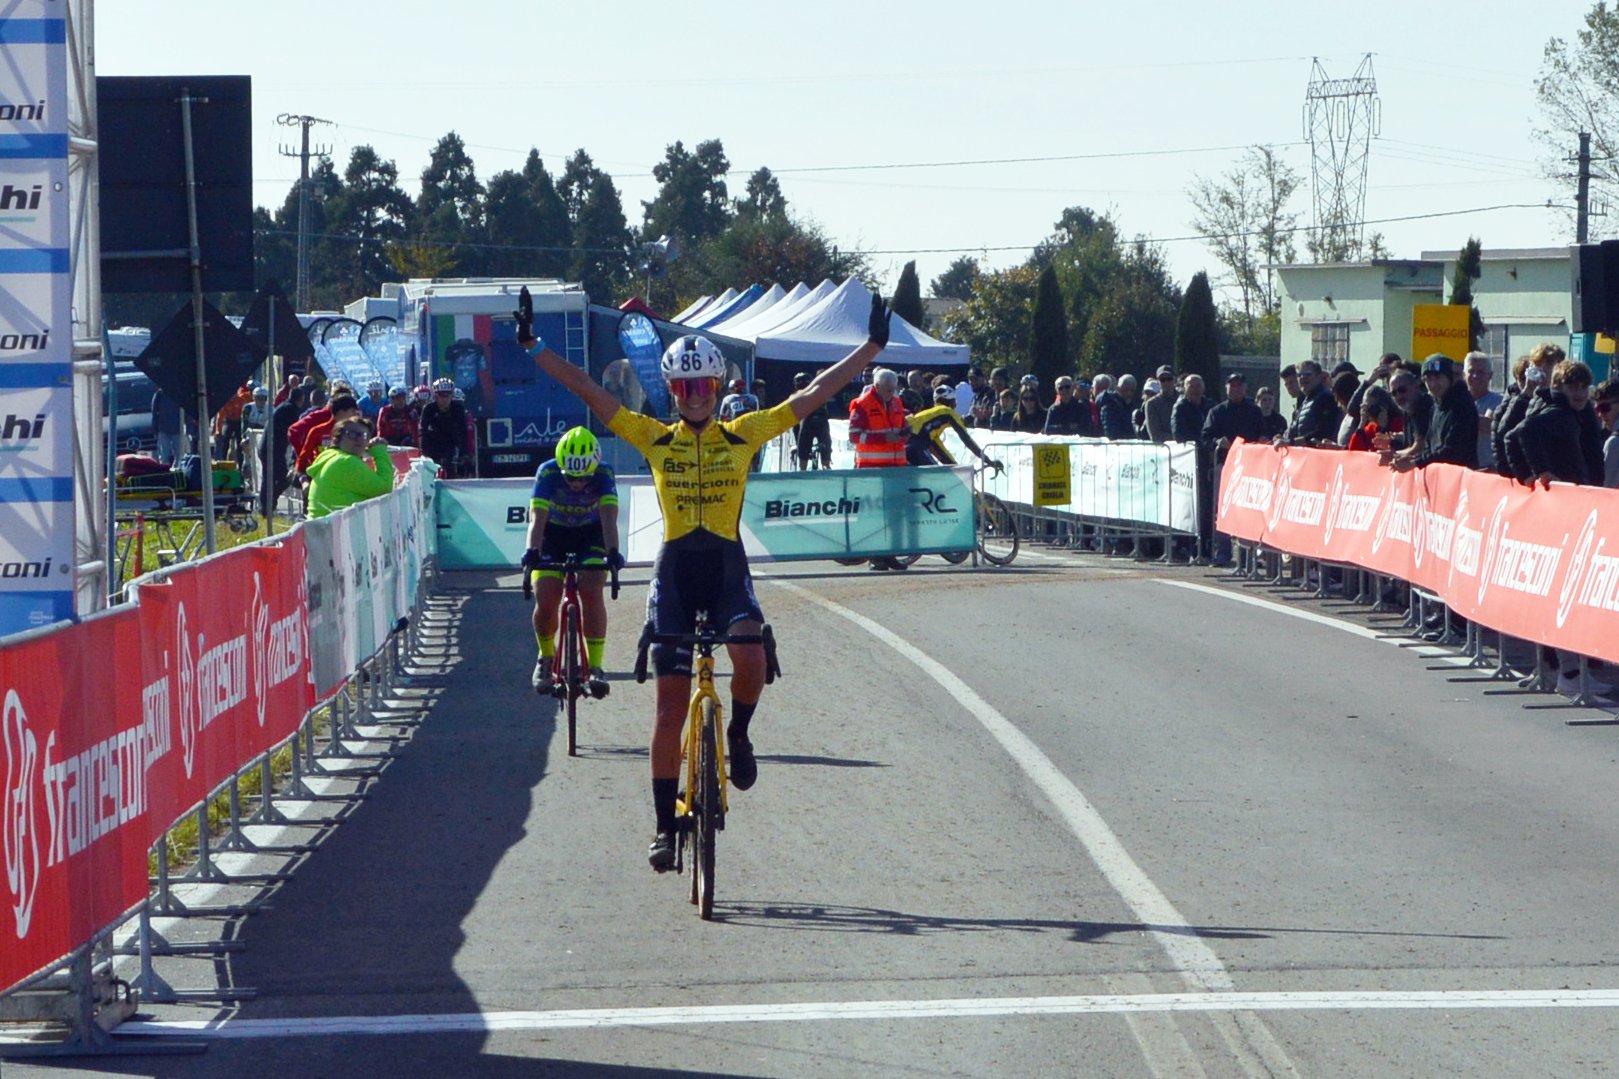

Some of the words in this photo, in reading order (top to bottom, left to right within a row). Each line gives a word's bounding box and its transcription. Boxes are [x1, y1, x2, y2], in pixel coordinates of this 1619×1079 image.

[1414, 327, 1468, 338] PASSAGGIO
[681, 353, 702, 372] 86
[0, 414, 45, 439] hi
[567, 457, 588, 471] 101
[765, 496, 860, 518] Bianchi
[0, 557, 51, 578] oni
[1491, 521, 1569, 598] francesconi
